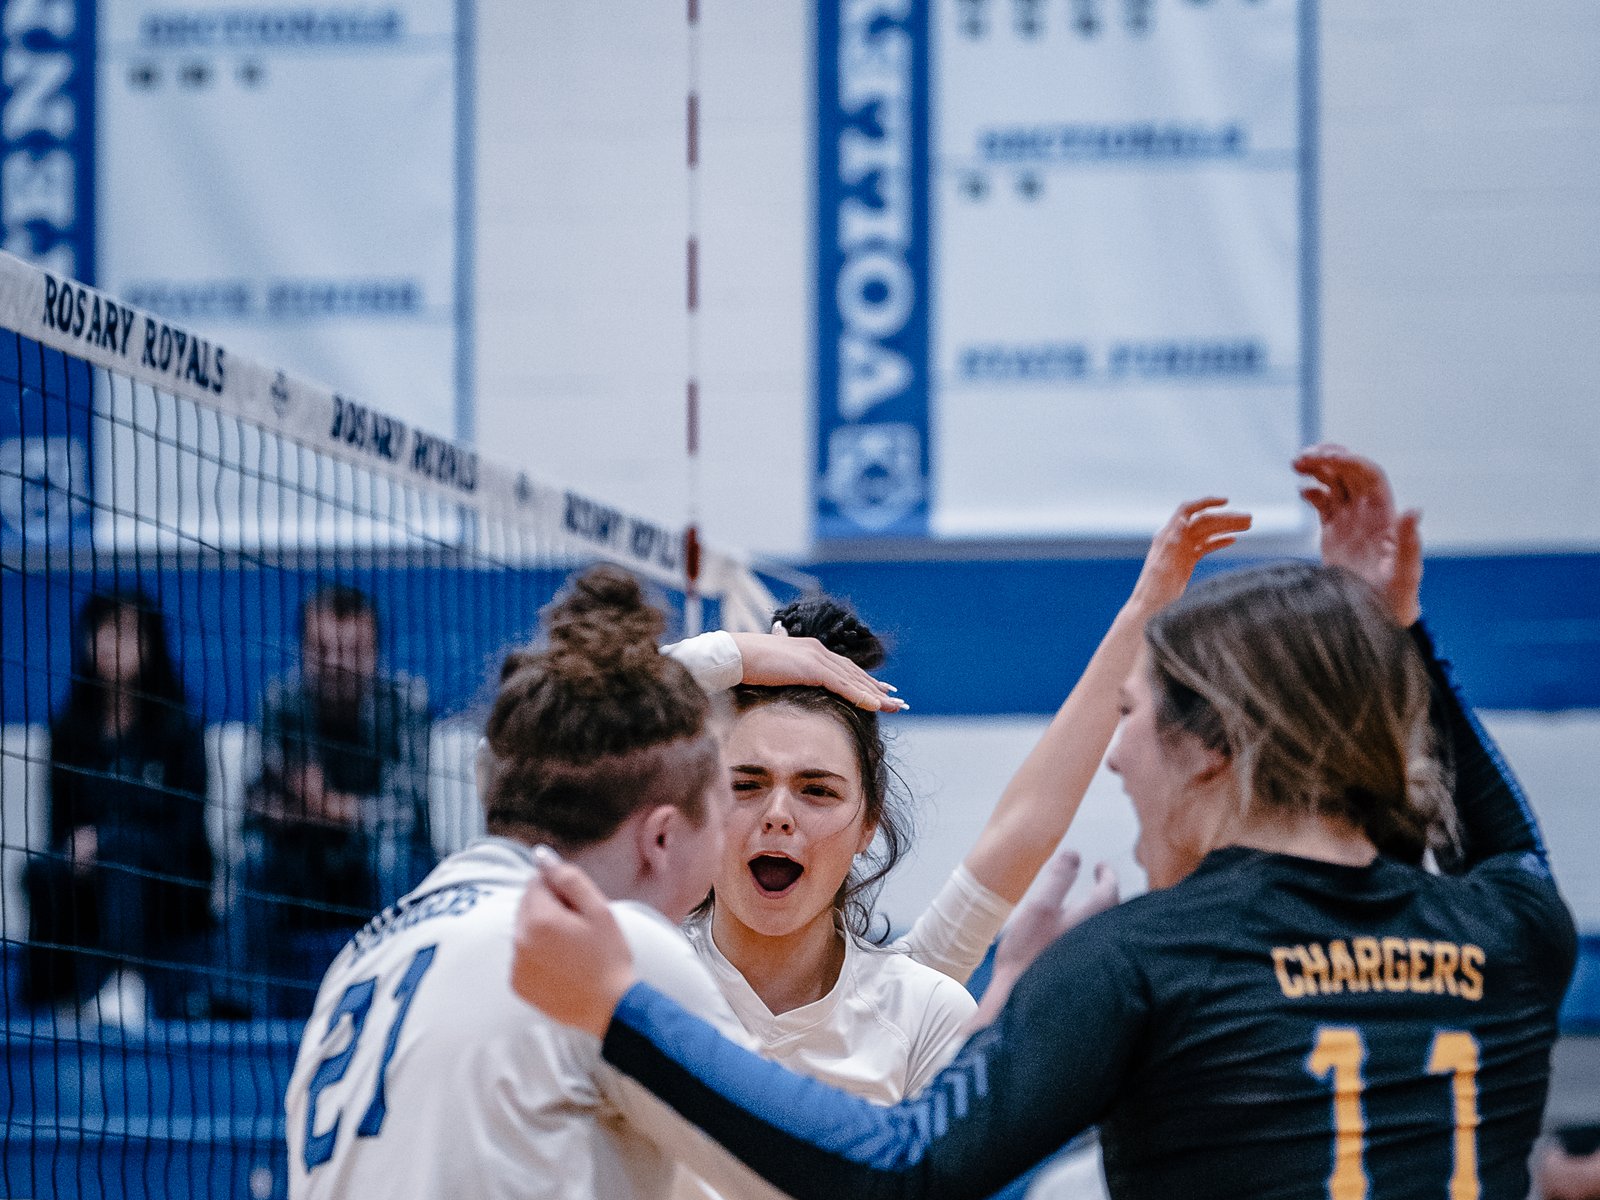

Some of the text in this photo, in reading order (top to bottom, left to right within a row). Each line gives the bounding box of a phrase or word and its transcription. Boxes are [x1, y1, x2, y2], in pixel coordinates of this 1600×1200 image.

[43, 273, 135, 358] ROSARY
[141, 316, 226, 394] ROYALS
[1271, 936, 1487, 1002] CHARGERS
[303, 943, 438, 1174] 21
